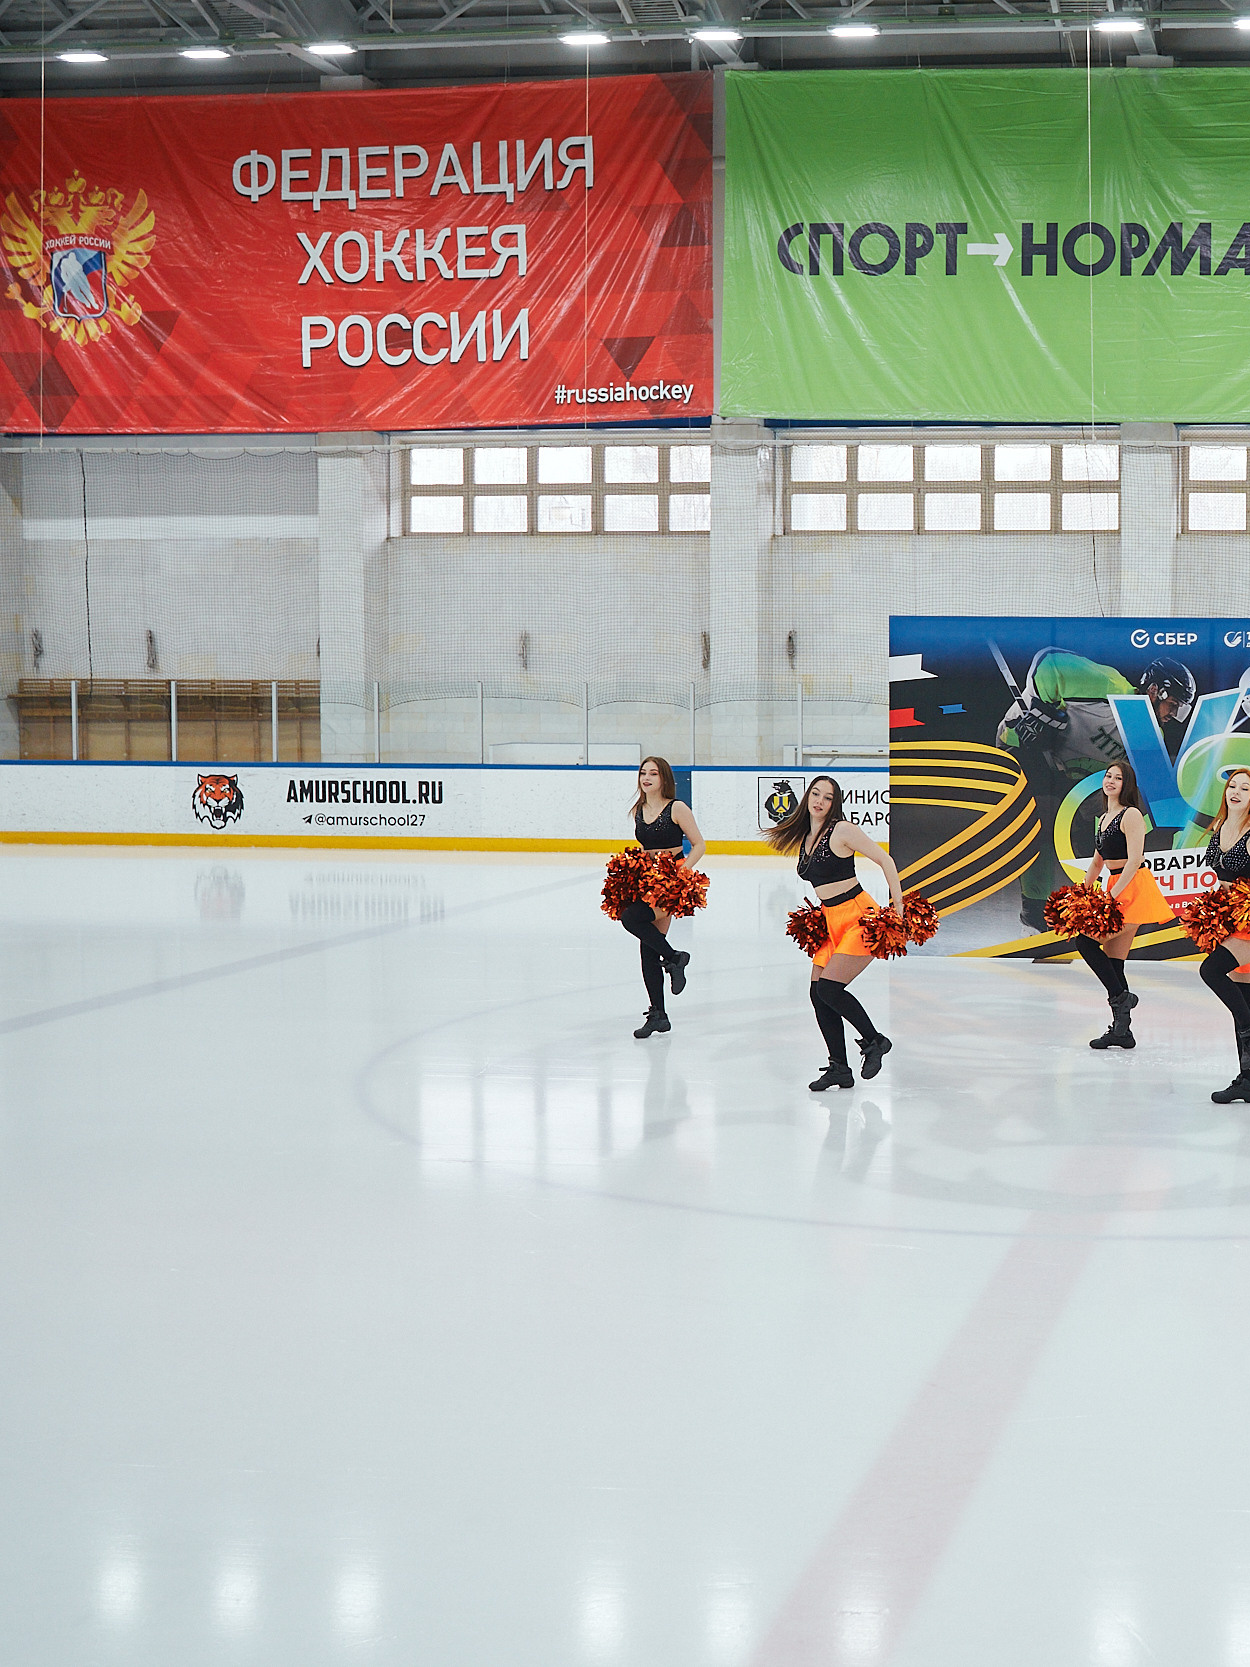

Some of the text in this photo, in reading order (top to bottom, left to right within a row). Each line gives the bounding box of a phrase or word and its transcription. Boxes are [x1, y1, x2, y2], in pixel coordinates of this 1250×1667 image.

[232, 135, 594, 212] ФЕДЕРАЦИЯ
[45, 235, 111, 250] ХОККЕЙ РОССИИ
[296, 224, 528, 284] ХОККЕЯ
[777, 222, 968, 276] СПОРТ
[301, 308, 529, 368] РОССИИ
[554, 379, 695, 405] #russiahockey
[1153, 632, 1198, 646] СБЕР
[286, 780, 443, 804] AMURSCHOOL.RU
[314, 813, 426, 827] @amurschool27
